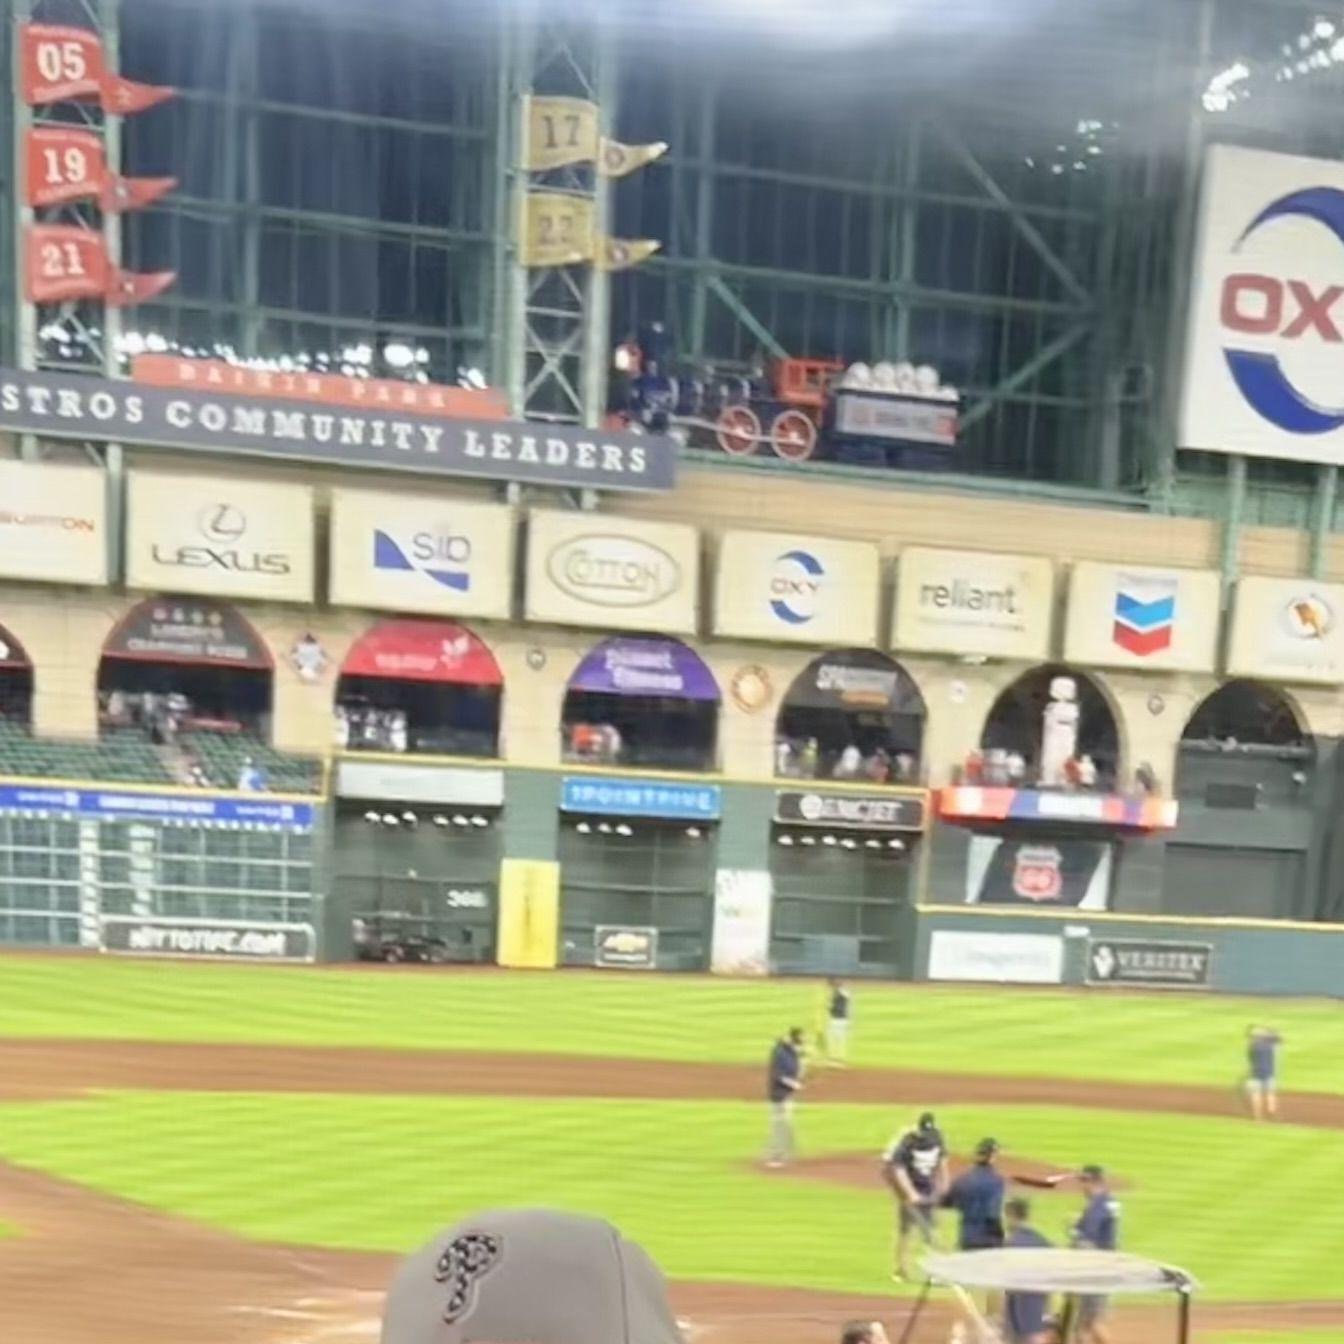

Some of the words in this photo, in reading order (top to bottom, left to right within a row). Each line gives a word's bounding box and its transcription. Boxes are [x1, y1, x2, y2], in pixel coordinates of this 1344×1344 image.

[37, 42, 86, 81] 05
[542, 114, 580, 148] 17
[44, 147, 86, 184] 19
[42, 241, 84, 278] 21
[353, 381, 446, 408] PARK
[166, 401, 444, 454] COMMUNITY
[464, 431, 648, 472] LEADERS
[152, 544, 291, 575] LEXUS
[771, 577, 820, 595] OXY
[919, 581, 1017, 614] reliant
